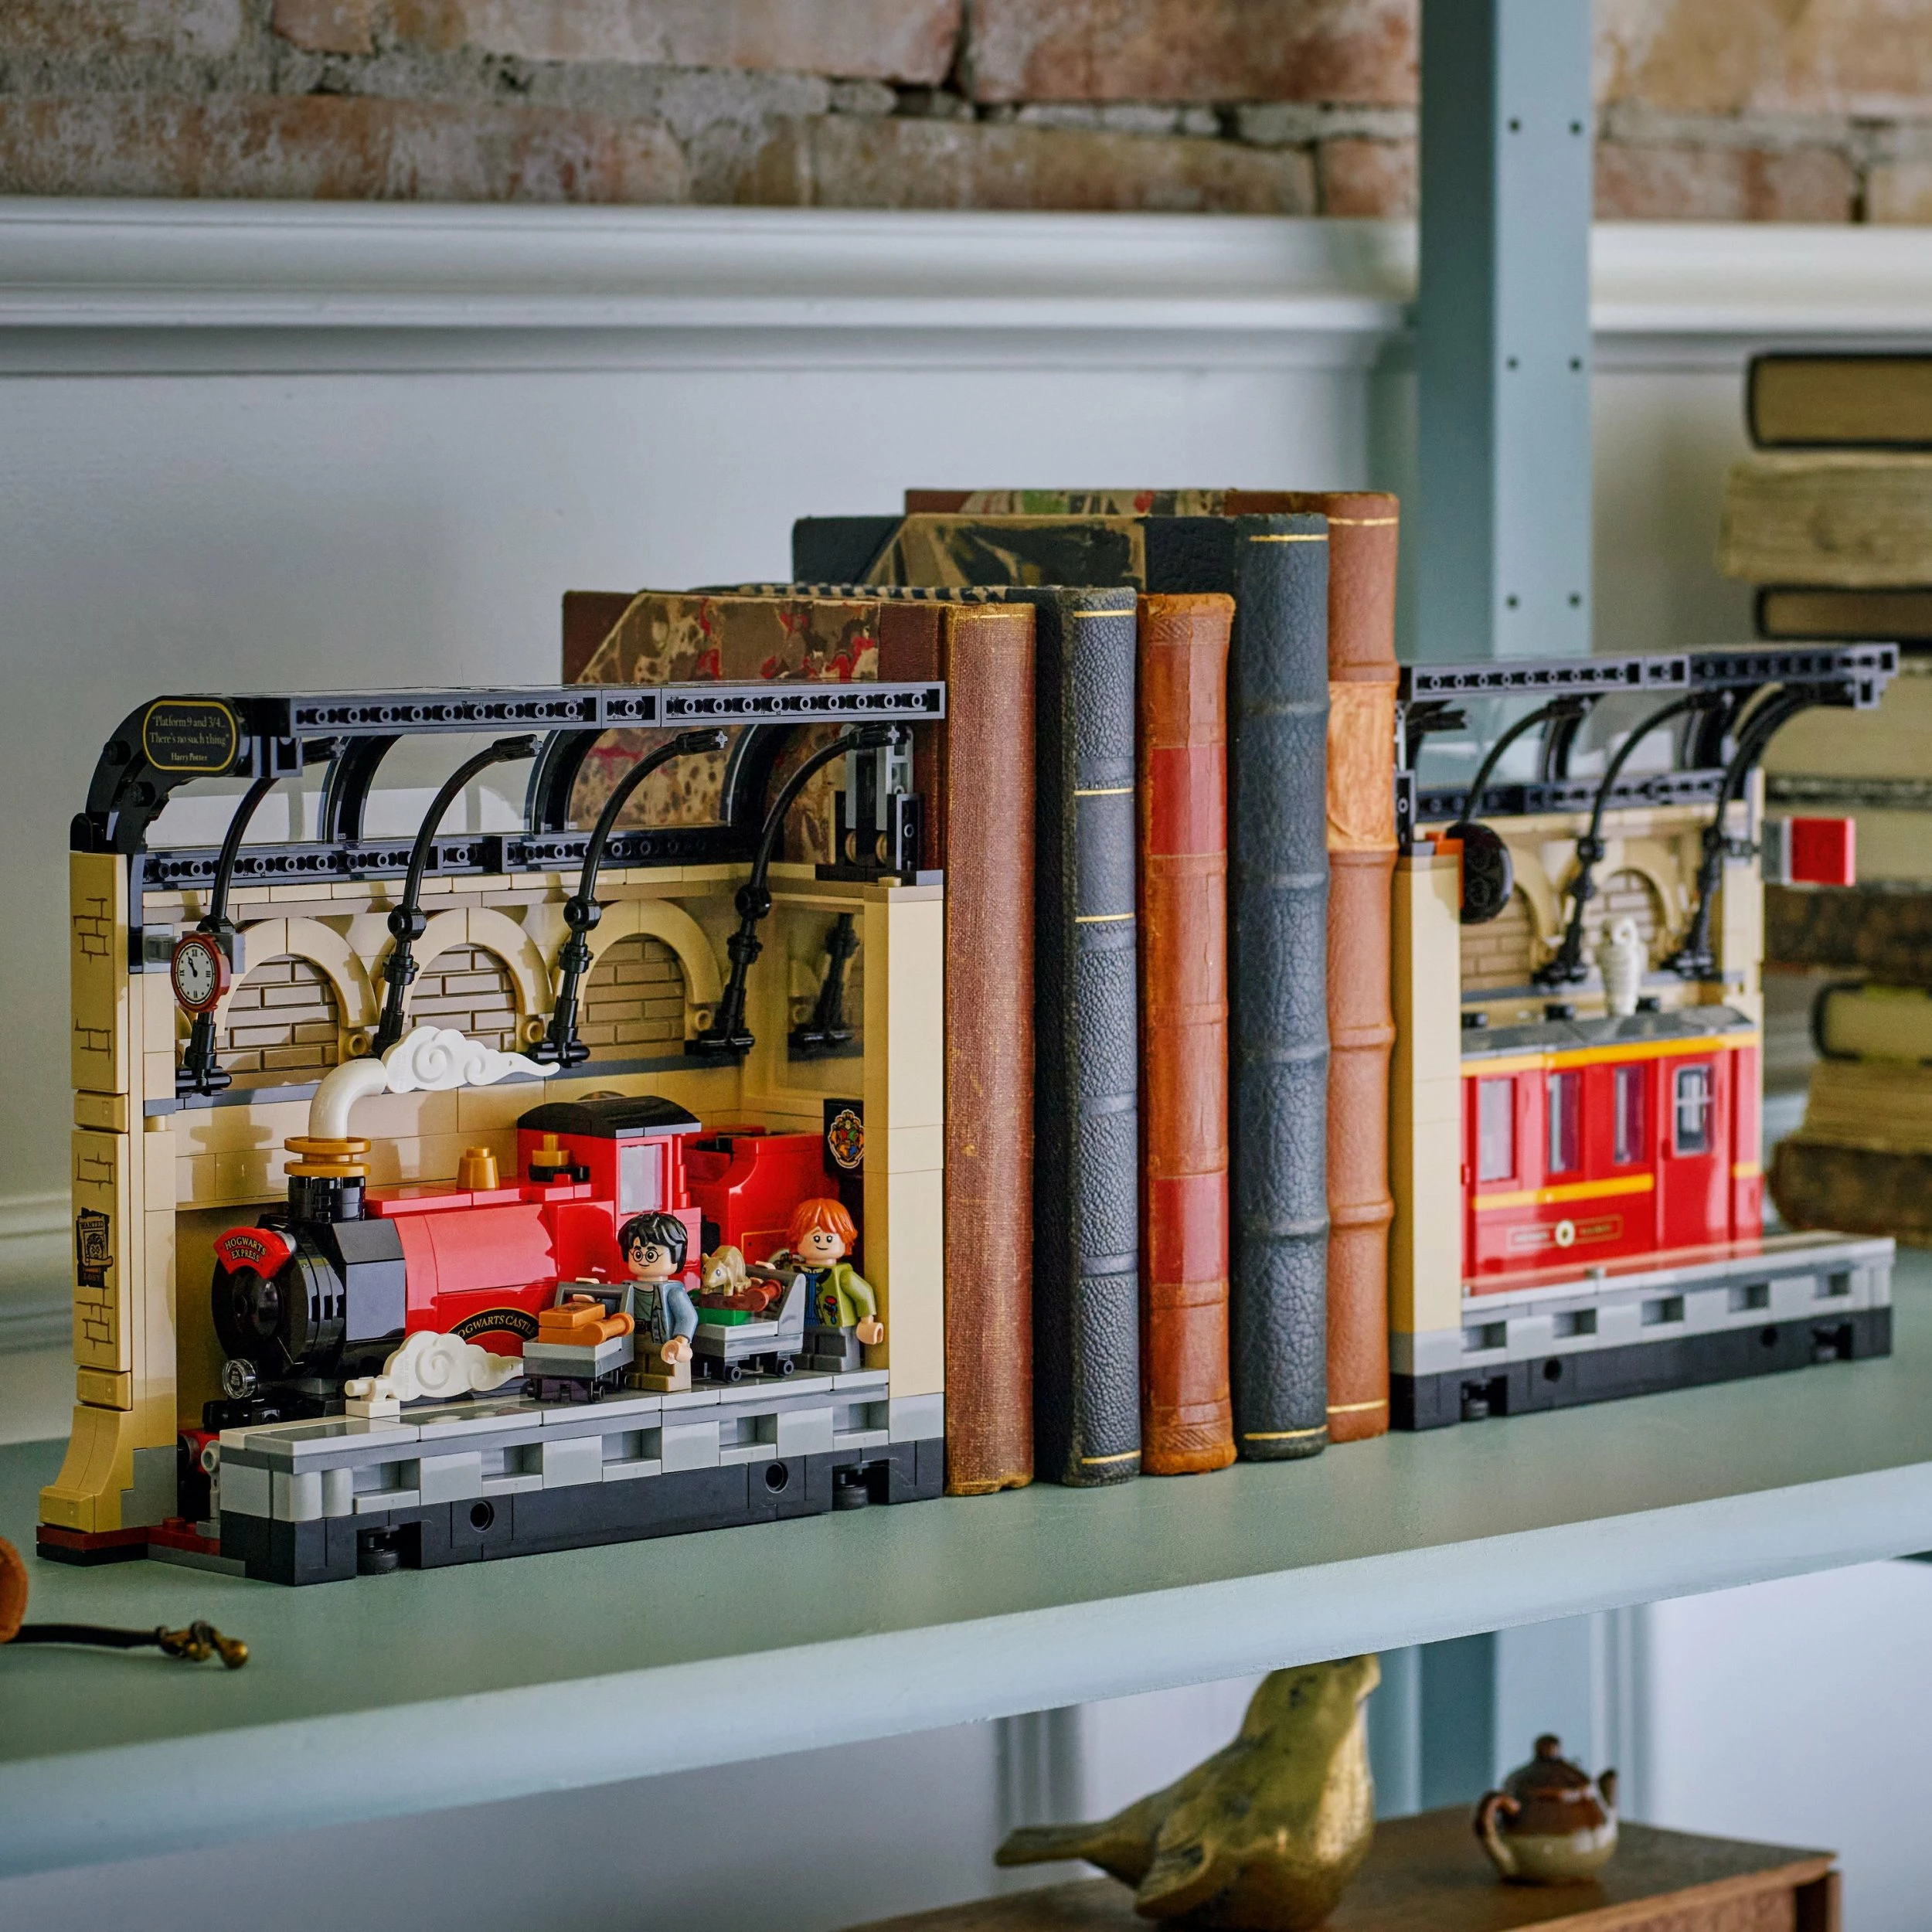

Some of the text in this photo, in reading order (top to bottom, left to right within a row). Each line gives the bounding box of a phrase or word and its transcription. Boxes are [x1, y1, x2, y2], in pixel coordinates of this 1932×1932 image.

[186, 716, 192, 726] 9
[194, 716, 207, 727] and
[149, 732, 176, 743] There's
[188, 733, 205, 744] such
[171, 753, 208, 762] Harry Potter
[224, 1236, 267, 1256] HOGWARTS
[231, 1249, 260, 1263] EXPRESS
[457, 1315, 536, 1337] OGWARTS CASTLE
